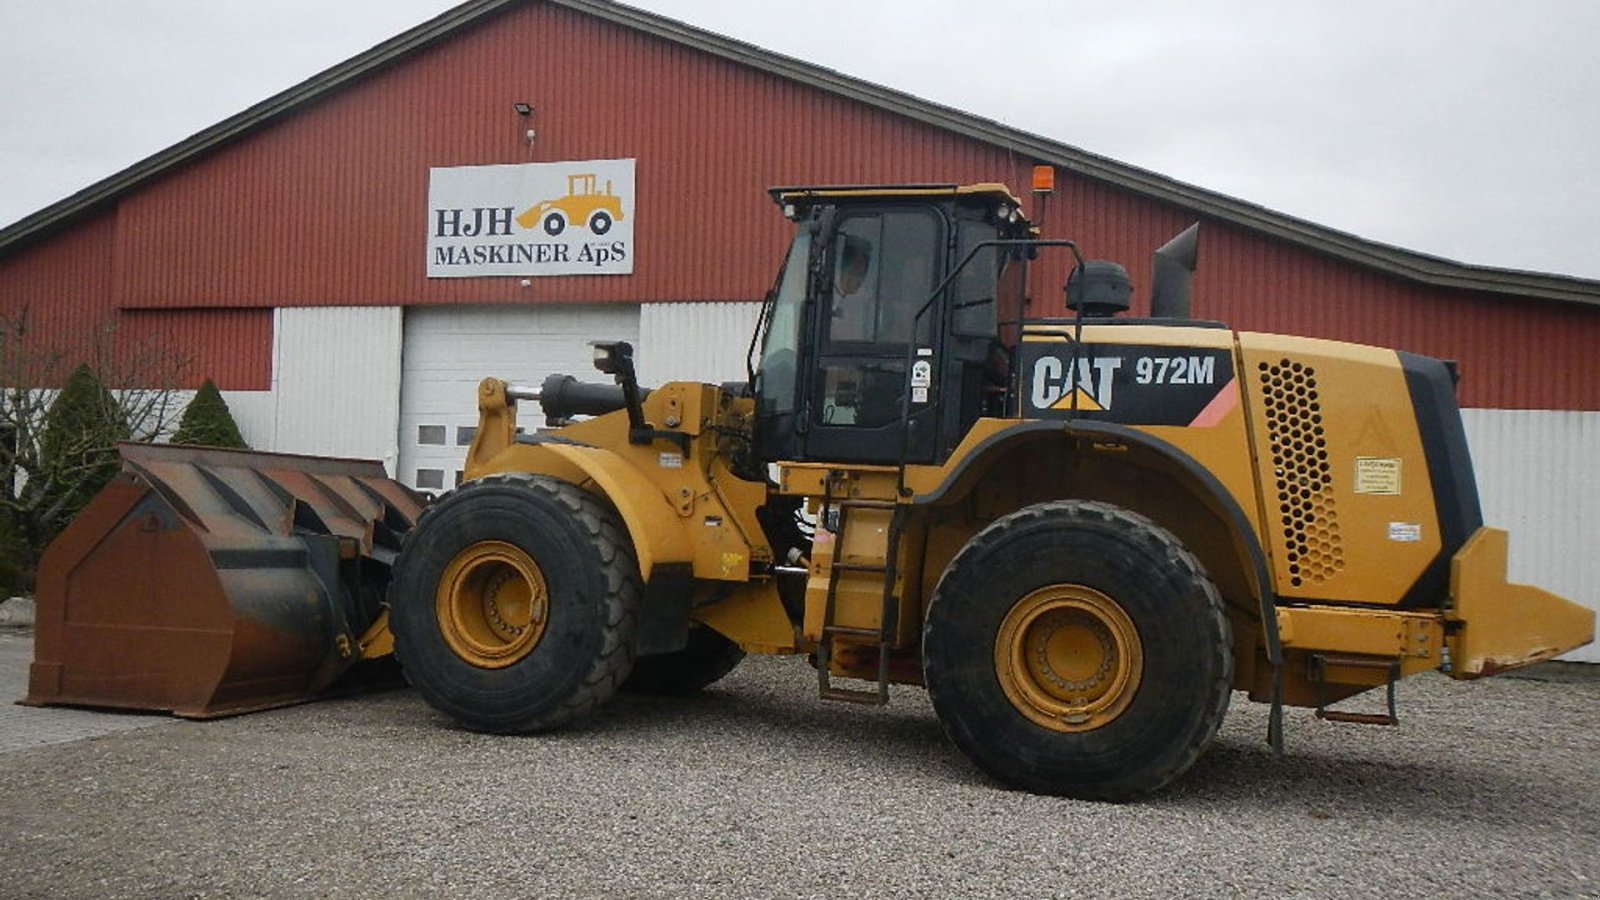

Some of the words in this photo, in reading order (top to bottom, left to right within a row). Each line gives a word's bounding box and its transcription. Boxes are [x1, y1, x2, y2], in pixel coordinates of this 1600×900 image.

[435, 207, 515, 237] HJH
[434, 243, 571, 265] MASKINER
[577, 241, 626, 266] ApS
[1031, 356, 1122, 410] CAT
[1136, 356, 1215, 385] 972M
